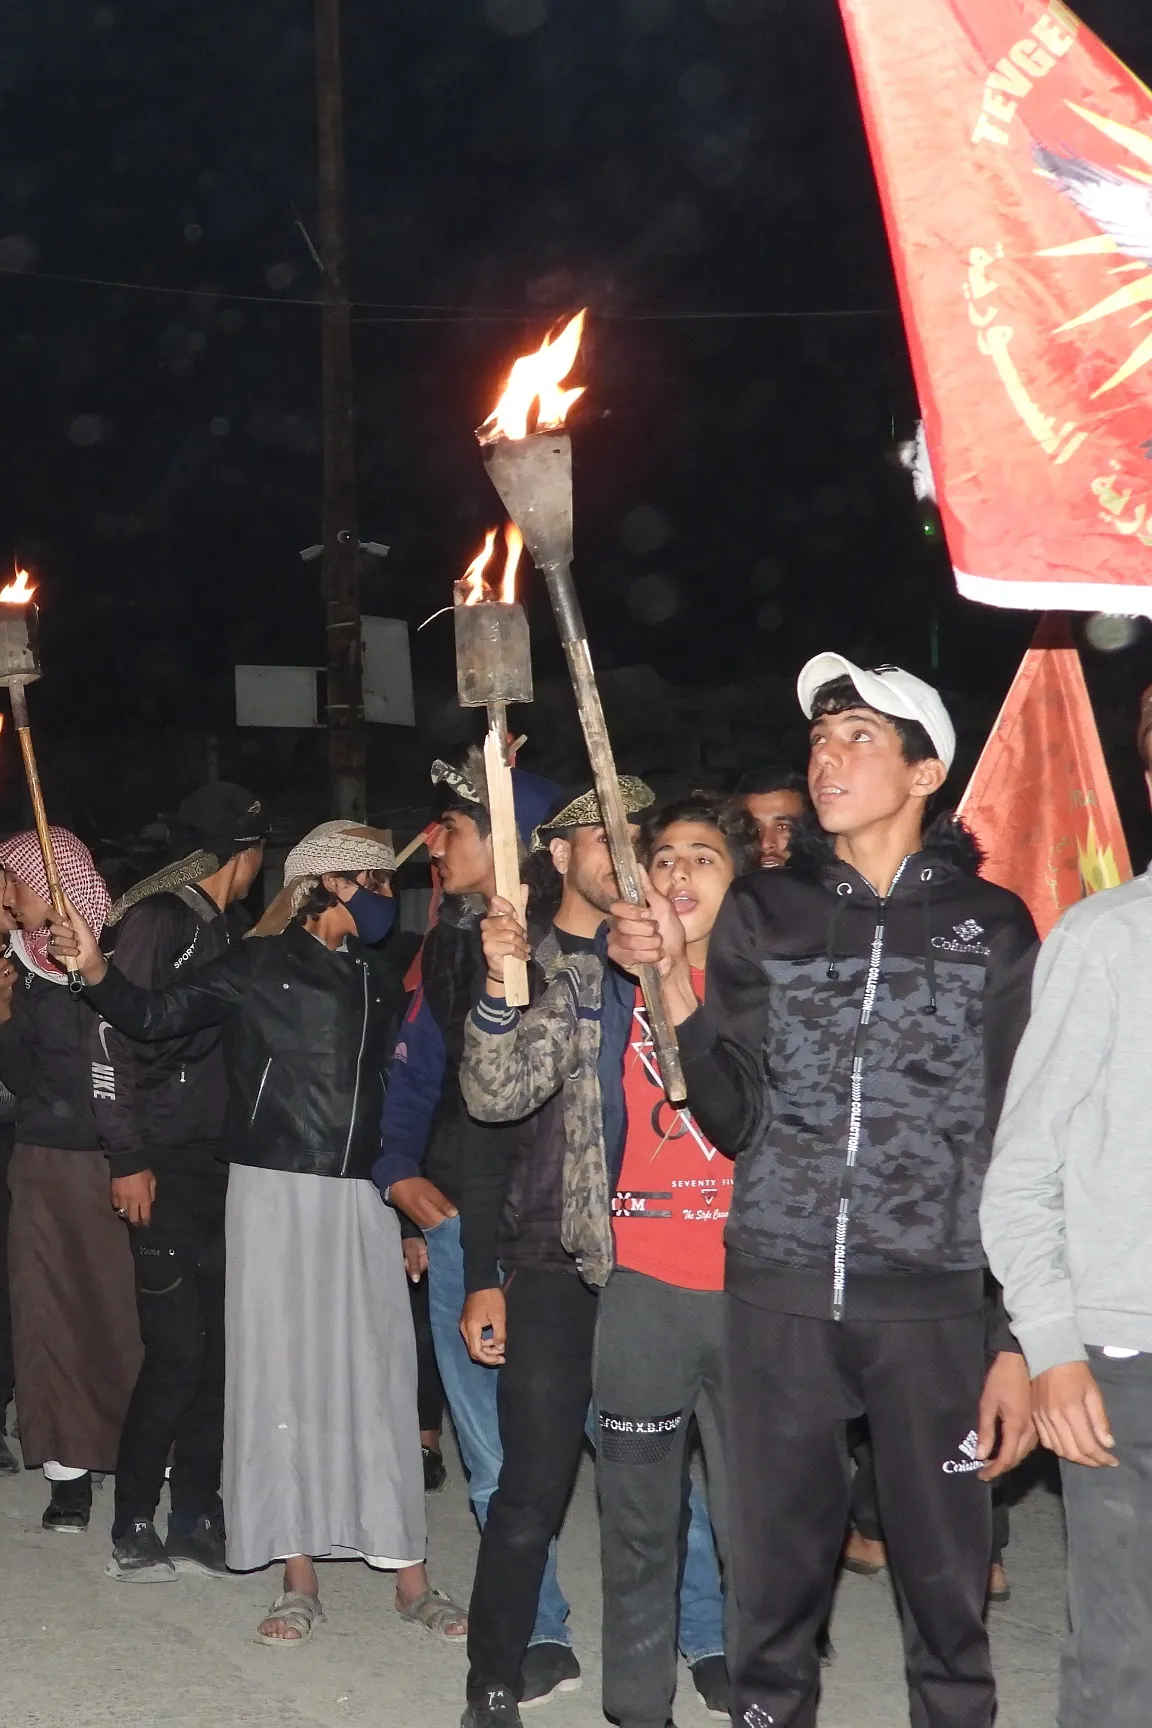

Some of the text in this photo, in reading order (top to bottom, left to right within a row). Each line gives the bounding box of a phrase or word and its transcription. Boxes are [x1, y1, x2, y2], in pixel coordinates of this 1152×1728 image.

[861, 967, 880, 1012] COLLECTION
[91, 1061, 116, 1101] NIKE
[848, 1101, 862, 1152] COLLECTION
[671, 1179, 716, 1188] SEVENTY
[833, 1244, 846, 1291] COLLECTION
